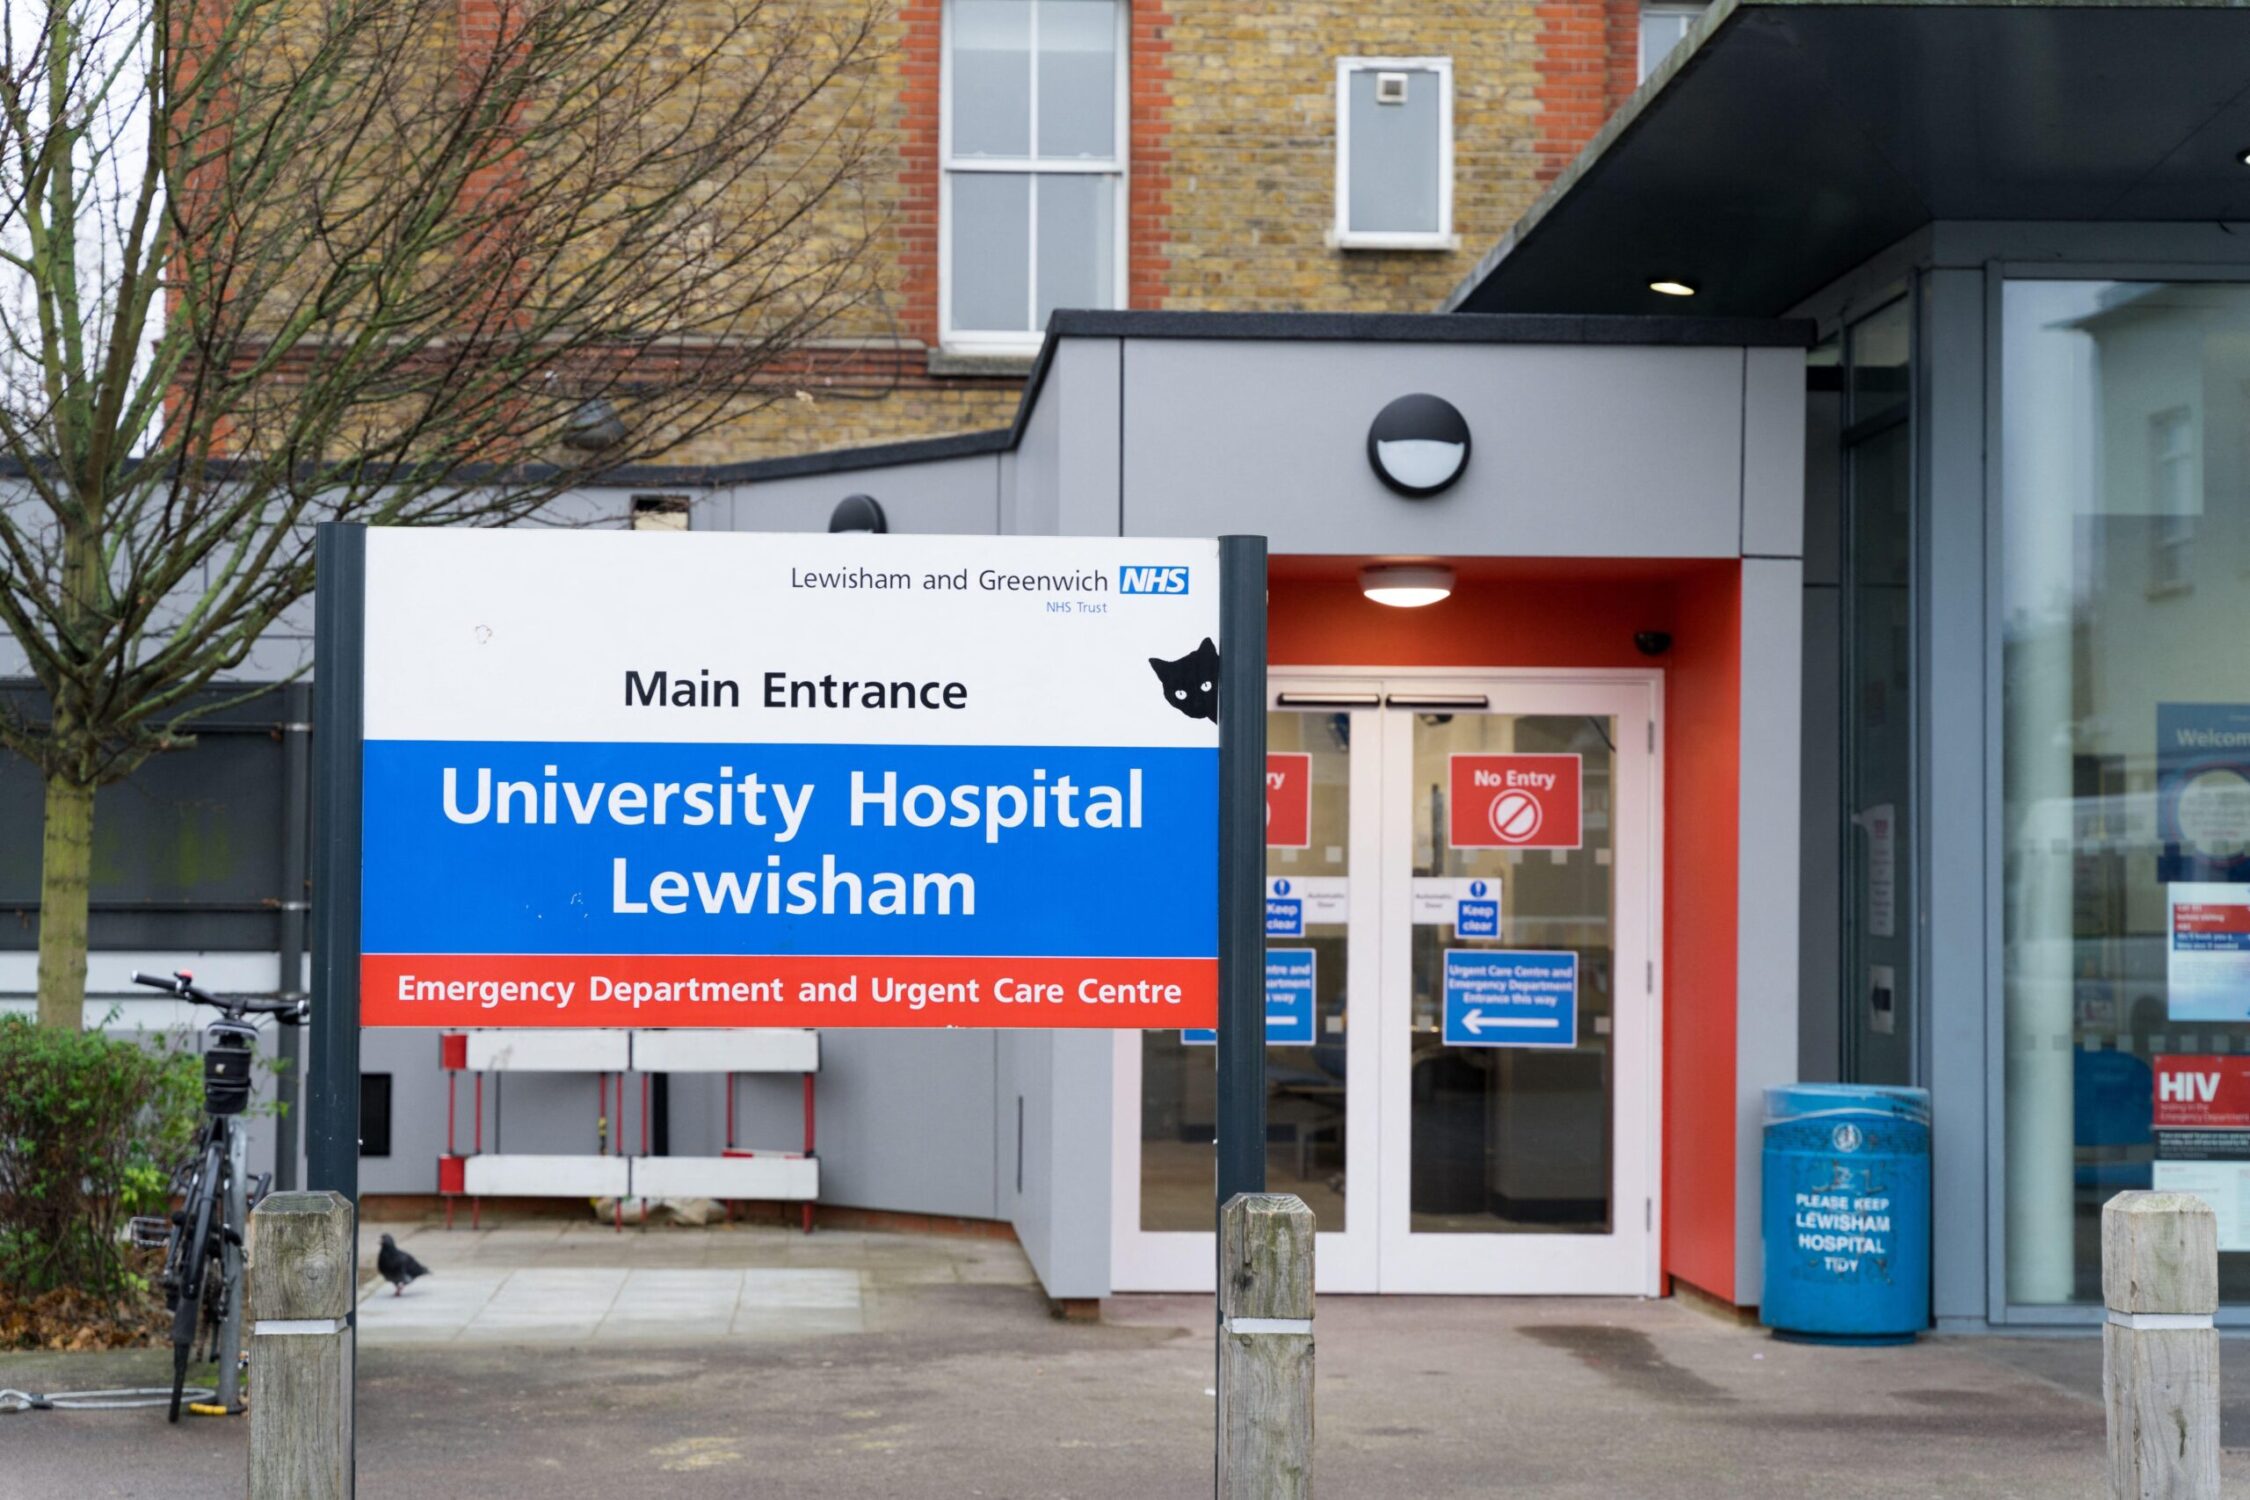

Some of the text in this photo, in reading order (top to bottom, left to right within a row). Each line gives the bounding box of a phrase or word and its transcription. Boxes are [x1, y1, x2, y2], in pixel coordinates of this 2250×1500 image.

[791, 566, 1187, 592] Lewisham and Greenwich NHS
[1046, 601, 1107, 614] NHS Trust
[625, 669, 968, 710] Main Entrance
[2177, 728, 2250, 747] Welcom
[1474, 770, 1556, 790] No Entry
[443, 764, 1142, 844] University Hospital
[613, 854, 975, 915] Lewisham
[1266, 903, 1298, 917] Keep
[1462, 904, 1494, 918] Keep
[1266, 918, 1297, 930] clear
[1462, 920, 1493, 932] clear
[1289, 964, 1311, 975] and
[1449, 965, 1573, 978] Urgent Care Centre and
[397, 975, 1182, 1010] Emergency Department and Urgent Care Centre
[1448, 978, 1573, 994] Emergency Department
[1271, 992, 1297, 1005] way
[1463, 992, 1558, 1008] Entrance this way
[2160, 1071, 2221, 1102] HIV
[1796, 1193, 1890, 1211] PLEASE KEEP
[1796, 1211, 1890, 1232] LEWISHAM
[1798, 1233, 1885, 1254] HOSPITAL
[1823, 1257, 1859, 1273] TIDY
